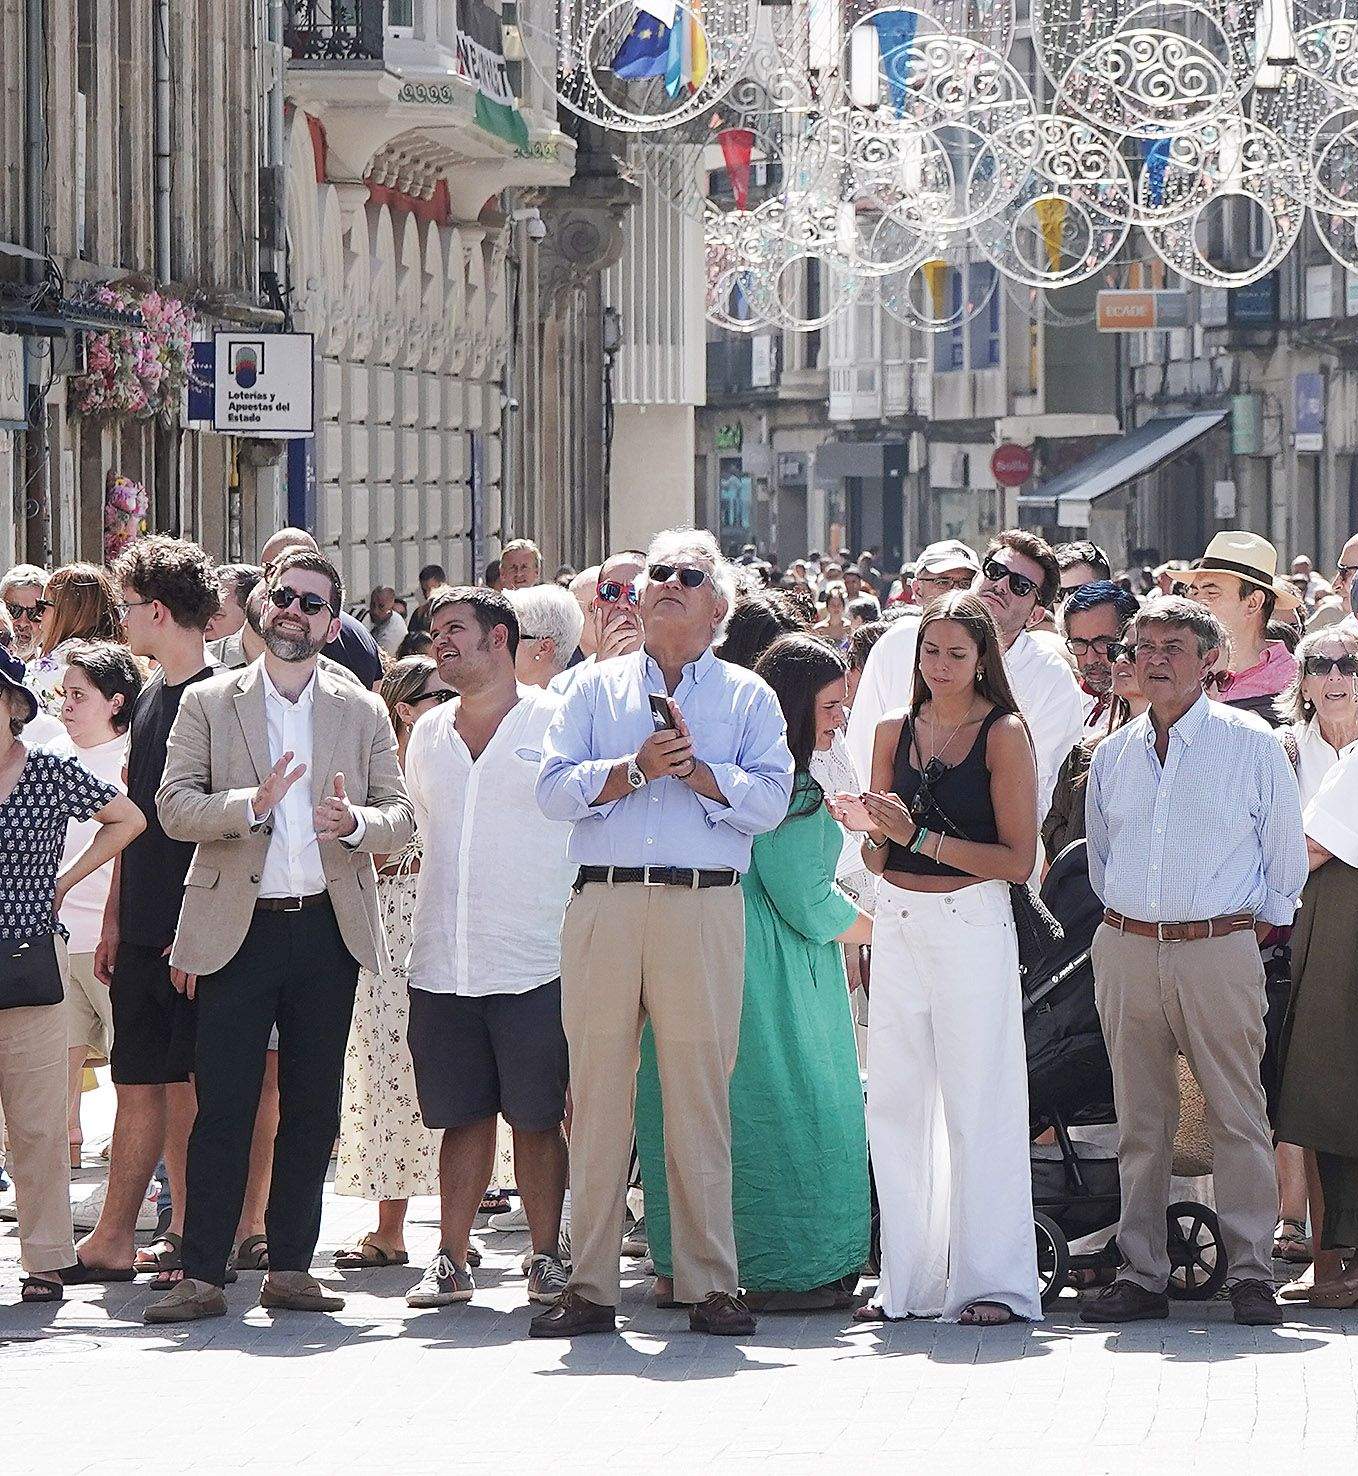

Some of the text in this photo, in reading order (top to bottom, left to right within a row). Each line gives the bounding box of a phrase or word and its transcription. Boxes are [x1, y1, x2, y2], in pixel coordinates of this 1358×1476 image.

[270, 393, 276, 401] y
[228, 402, 290, 411] Apuestas del
[228, 413, 261, 422] Estado
